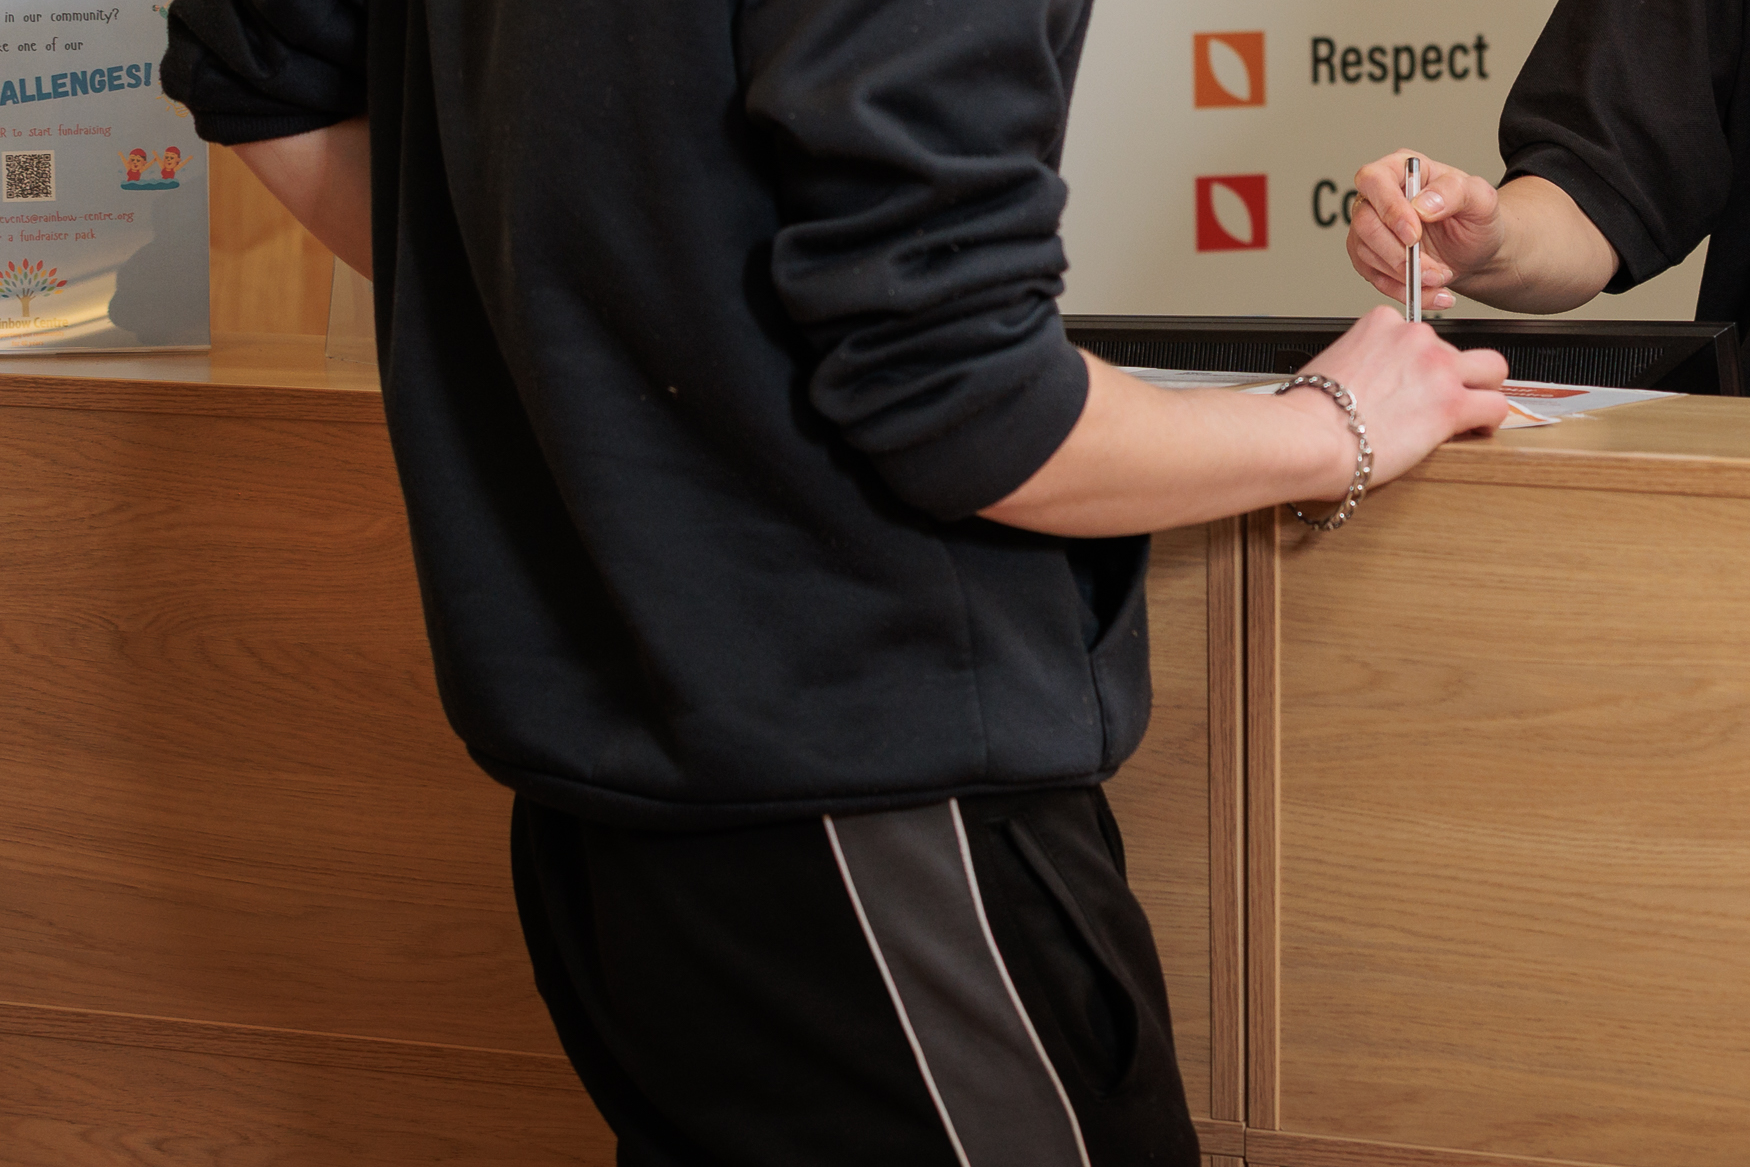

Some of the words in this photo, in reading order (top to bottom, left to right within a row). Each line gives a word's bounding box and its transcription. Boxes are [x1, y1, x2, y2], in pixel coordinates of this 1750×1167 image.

[4, 11, 15, 23] in
[23, 11, 42, 23] our
[50, 8, 120, 24] community?
[17, 41, 37, 52] one
[45, 36, 58, 52] of
[64, 41, 84, 51] our
[1310, 34, 1490, 95] Respect
[0, 62, 152, 106] ALLENGES!
[12, 128, 22, 138] to
[29, 126, 53, 137] start
[58, 123, 112, 138] fundraising
[8, 234, 14, 242] a
[19, 229, 69, 243] fundraiser
[75, 228, 97, 241] pack
[34, 316, 69, 328] Centre
